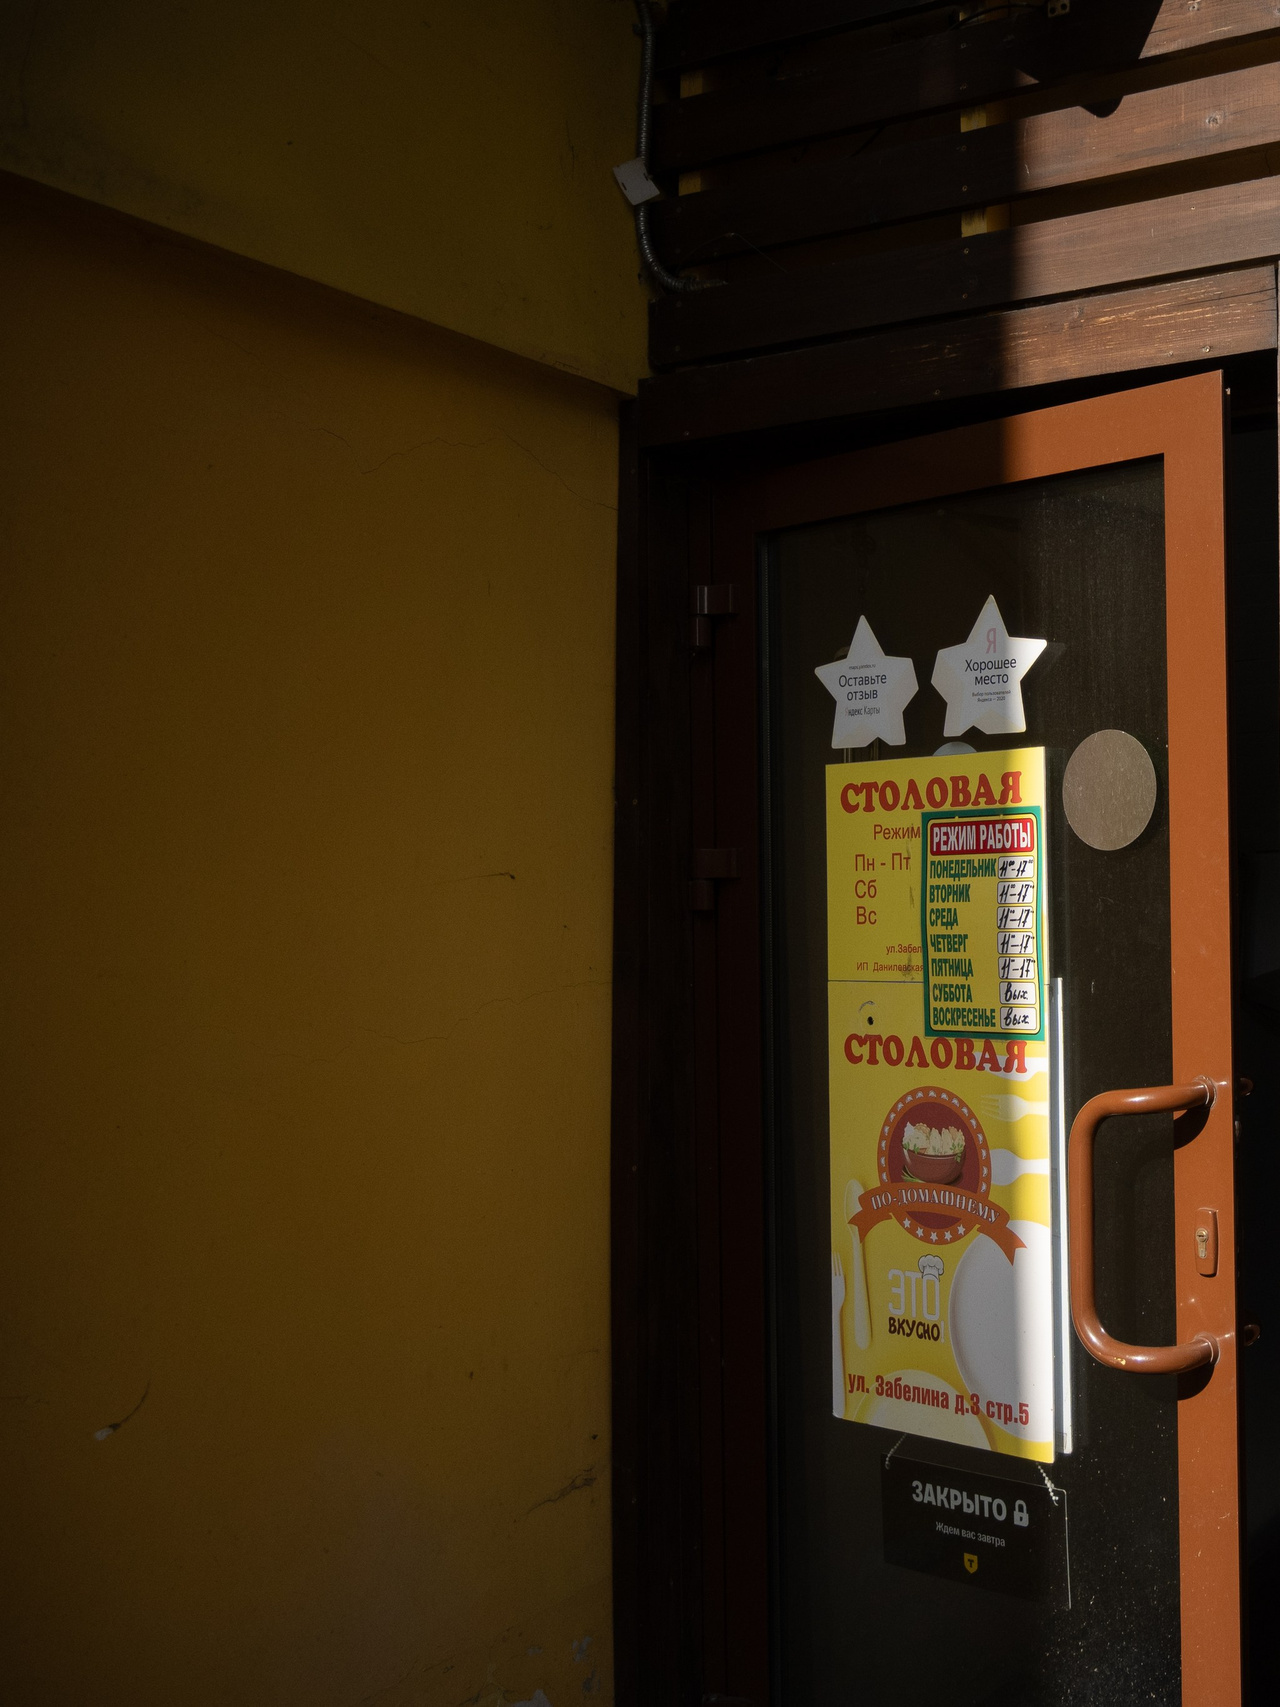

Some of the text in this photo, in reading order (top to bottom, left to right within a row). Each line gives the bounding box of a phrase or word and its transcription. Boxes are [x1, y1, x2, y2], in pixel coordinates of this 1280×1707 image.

[985, 627, 997, 654] Я
[965, 658, 1017, 673] Хорошее
[838, 674, 887, 688] Оставьте
[974, 673, 1009, 686] место
[846, 689, 878, 701] отзыв
[845, 706, 881, 717] Яндекс Карты
[840, 770, 1022, 814] СТОЛОВАЯ
[873, 824, 921, 841] Режим
[933, 822, 1031, 852] РЕЖИМ РАБОТЫ
[855, 854, 875, 872] Пн
[891, 852, 911, 871] Пт
[929, 858, 997, 881] ПОНЕДЕЛЬНИК
[855, 879, 877, 899] Сб
[929, 883, 971, 903] ВТОРНИК
[856, 905, 877, 925] Вс
[929, 907, 958, 930] СРЕДА
[930, 933, 969, 953] ЧЕТВЕРГ
[856, 961, 924, 973] ИП Данилевская
[931, 958, 974, 981] ПЯТНИЦА
[932, 983, 973, 1003] СУББОТА
[933, 1007, 996, 1028] ВОСКРЕСЕНЬЕ
[844, 1033, 1027, 1074] СТОЛОВАЯ
[870, 1187, 1000, 1224] ПО-ДОМАШНЕМУ
[887, 1268, 940, 1321] ЭТО
[888, 1316, 945, 1344] ВКУСНО!
[848, 1373, 1030, 1426] ул. Забелина д.3 стр.5
[911, 1480, 1007, 1522] ЗАКРЫТО
[935, 1521, 1006, 1548] Ждем вас завтра
